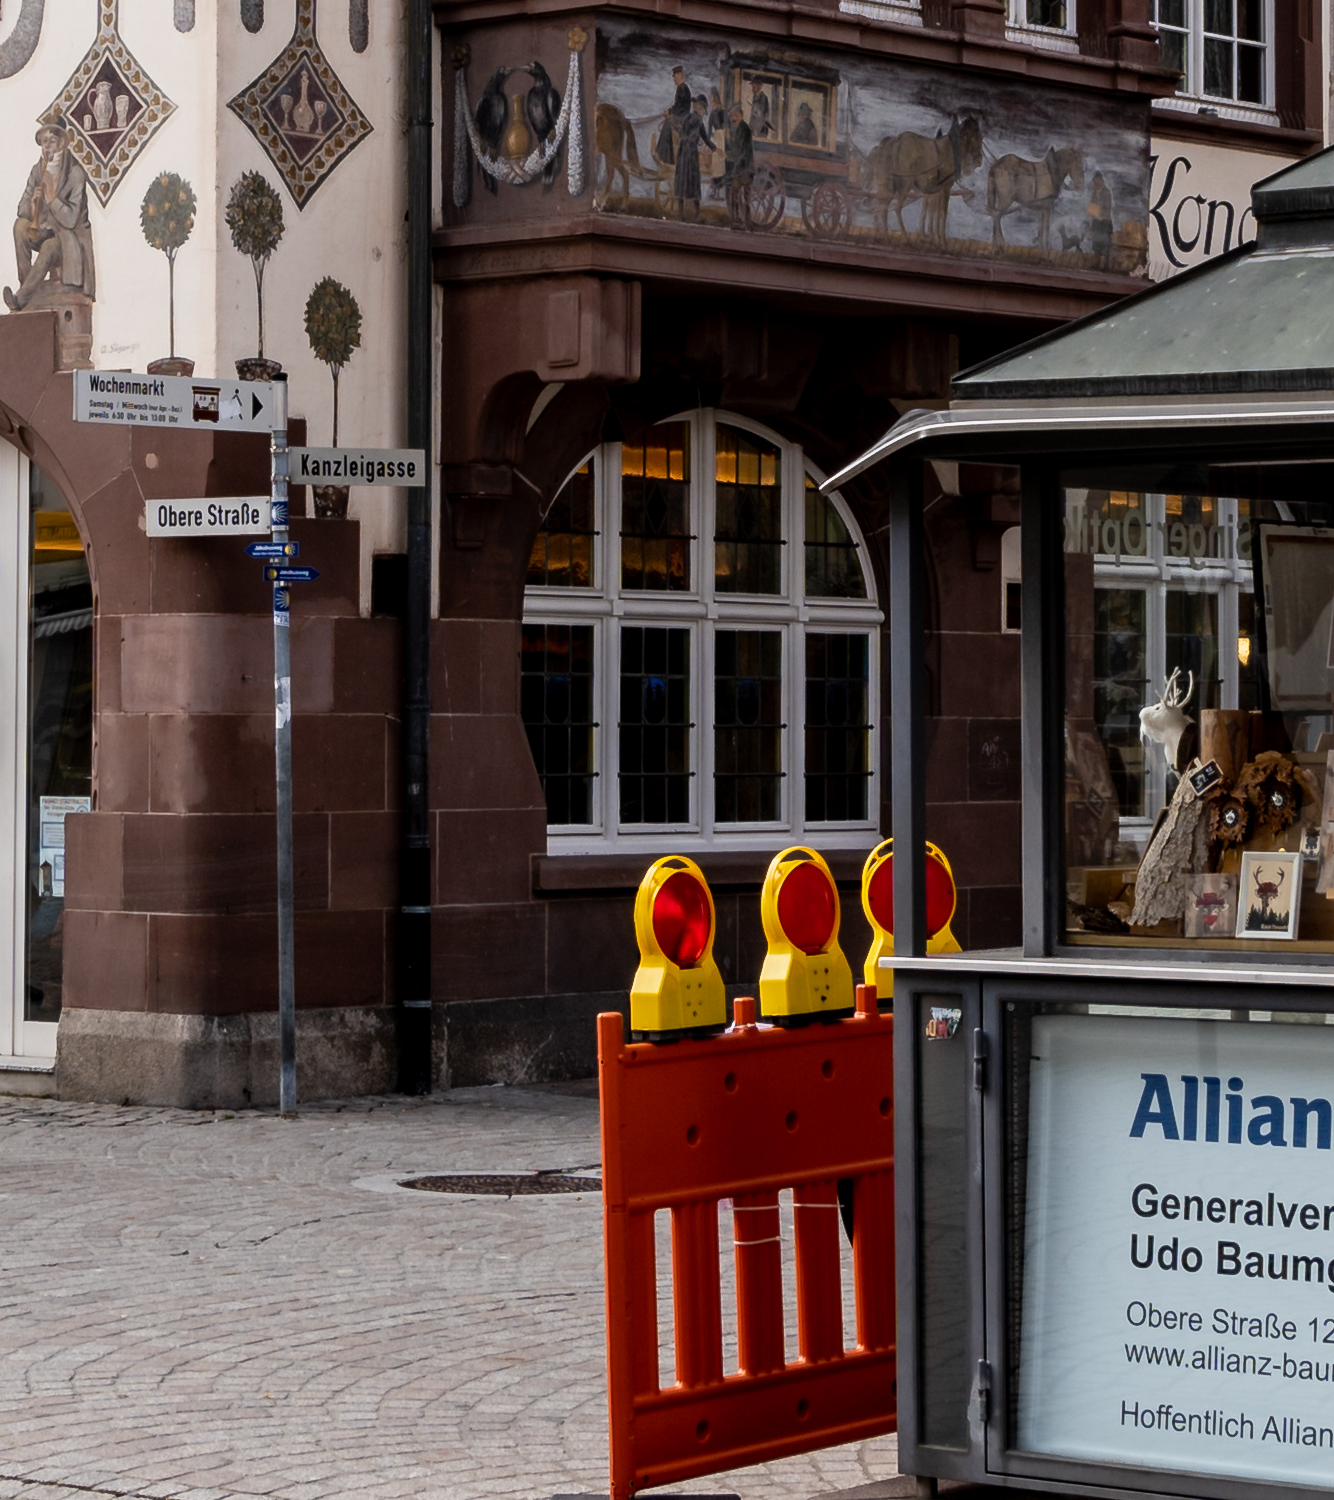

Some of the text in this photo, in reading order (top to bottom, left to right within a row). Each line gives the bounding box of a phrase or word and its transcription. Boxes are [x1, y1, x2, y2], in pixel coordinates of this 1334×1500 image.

[89, 375, 164, 396] Wochenmarkt
[300, 453, 416, 483] Kanzleigasse
[158, 503, 260, 528] Obere Straße
[1130, 1233, 1203, 1273] Udo
[1126, 1301, 1203, 1332] Obere
[1211, 1308, 1297, 1341] Straße
[1121, 1400, 1254, 1440] Hoffentlich
